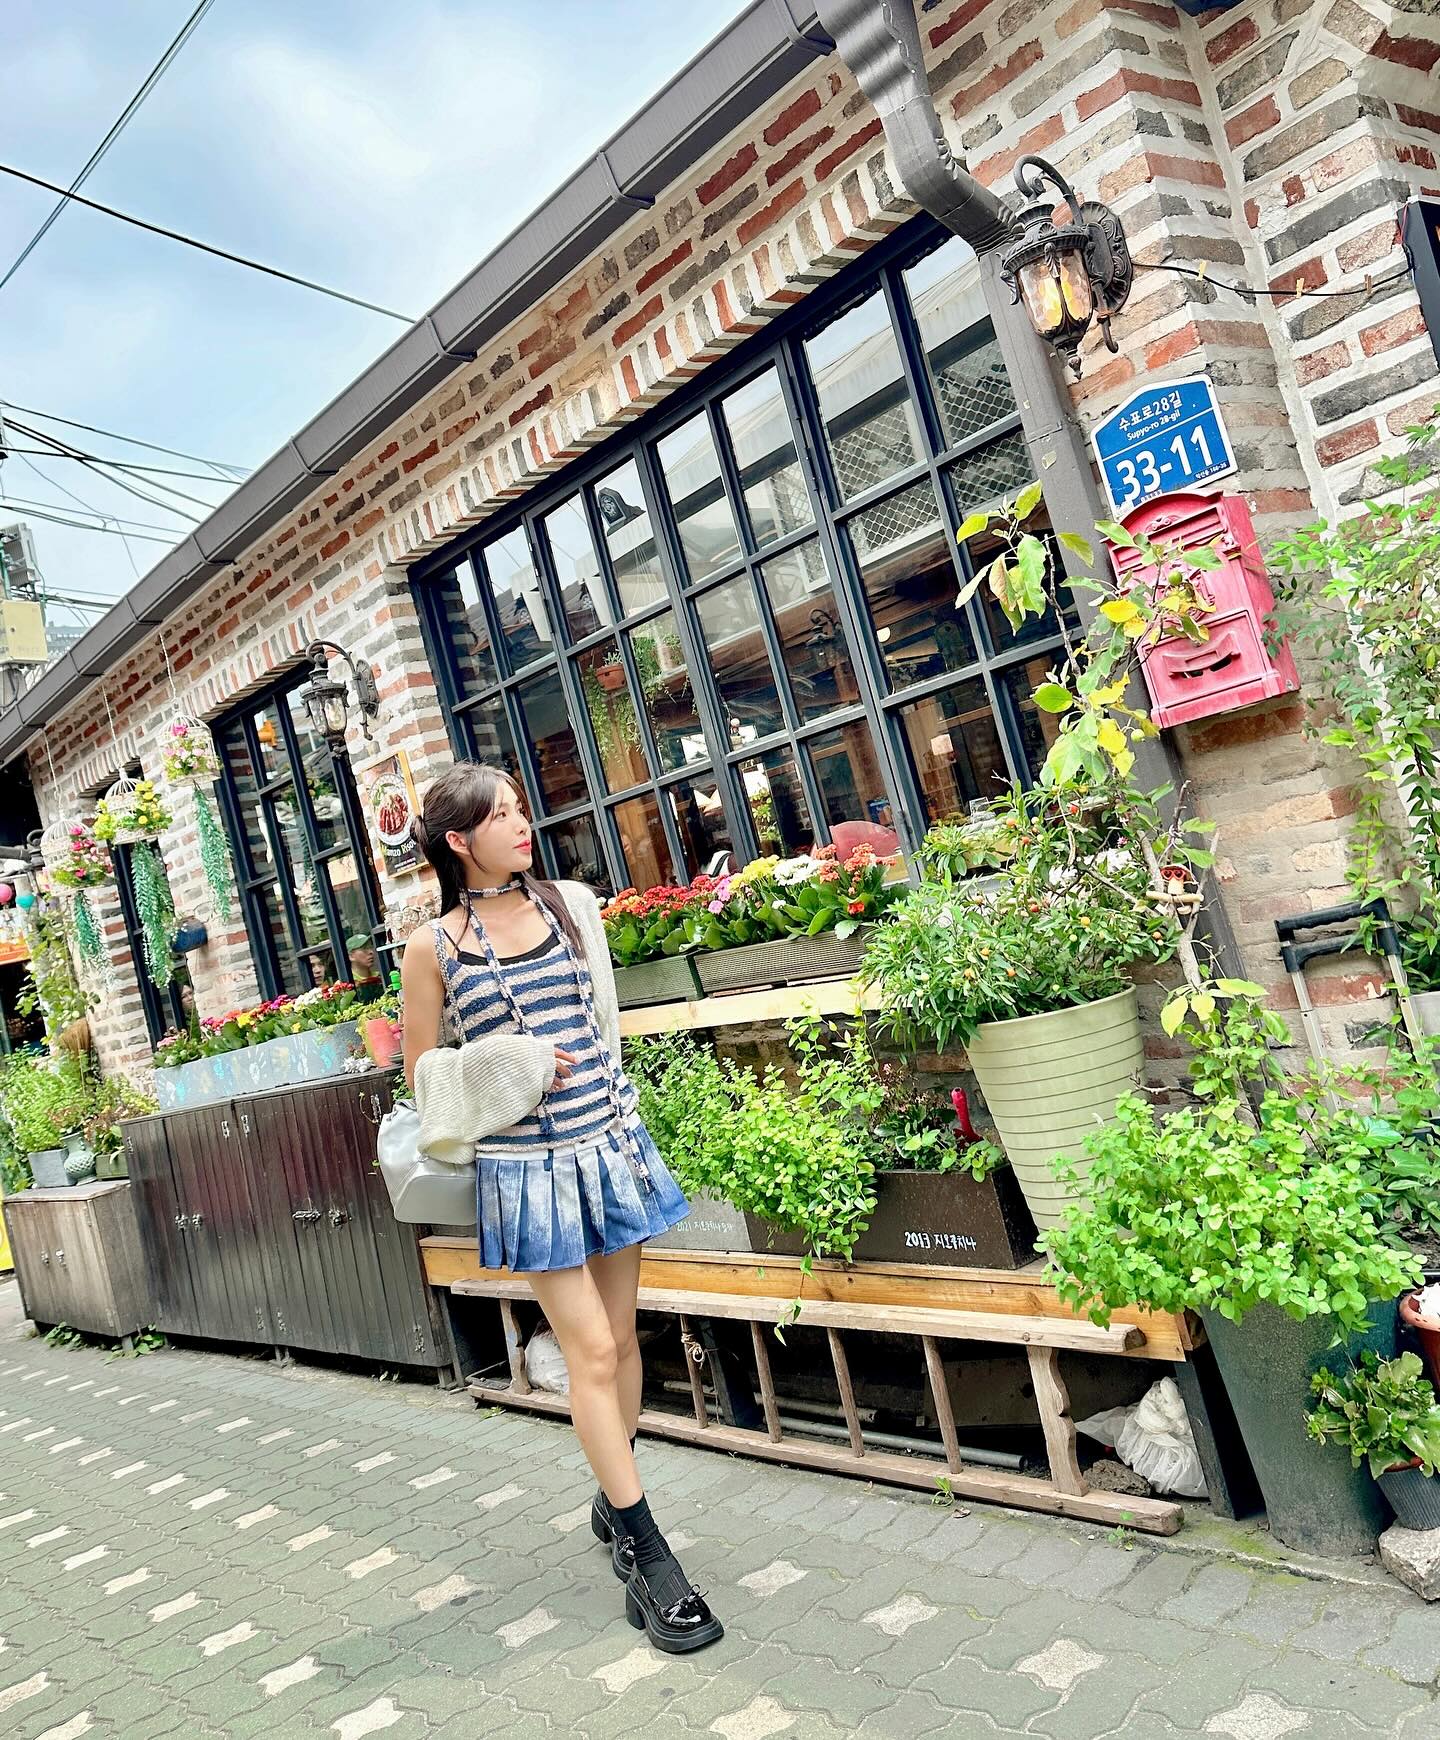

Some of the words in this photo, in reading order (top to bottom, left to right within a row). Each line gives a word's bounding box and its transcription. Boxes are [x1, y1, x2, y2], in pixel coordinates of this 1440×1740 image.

[1118, 390, 1183, 431] 수표로28길
[1126, 421, 1160, 441] Supyo-ro
[1160, 410, 1181, 426] 28-gil
[1116, 424, 1213, 502] 33-11
[401, 839, 416, 854] Risot
[904, 1231, 931, 1249] 2013
[933, 1233, 977, 1252] 지오쿠치나
